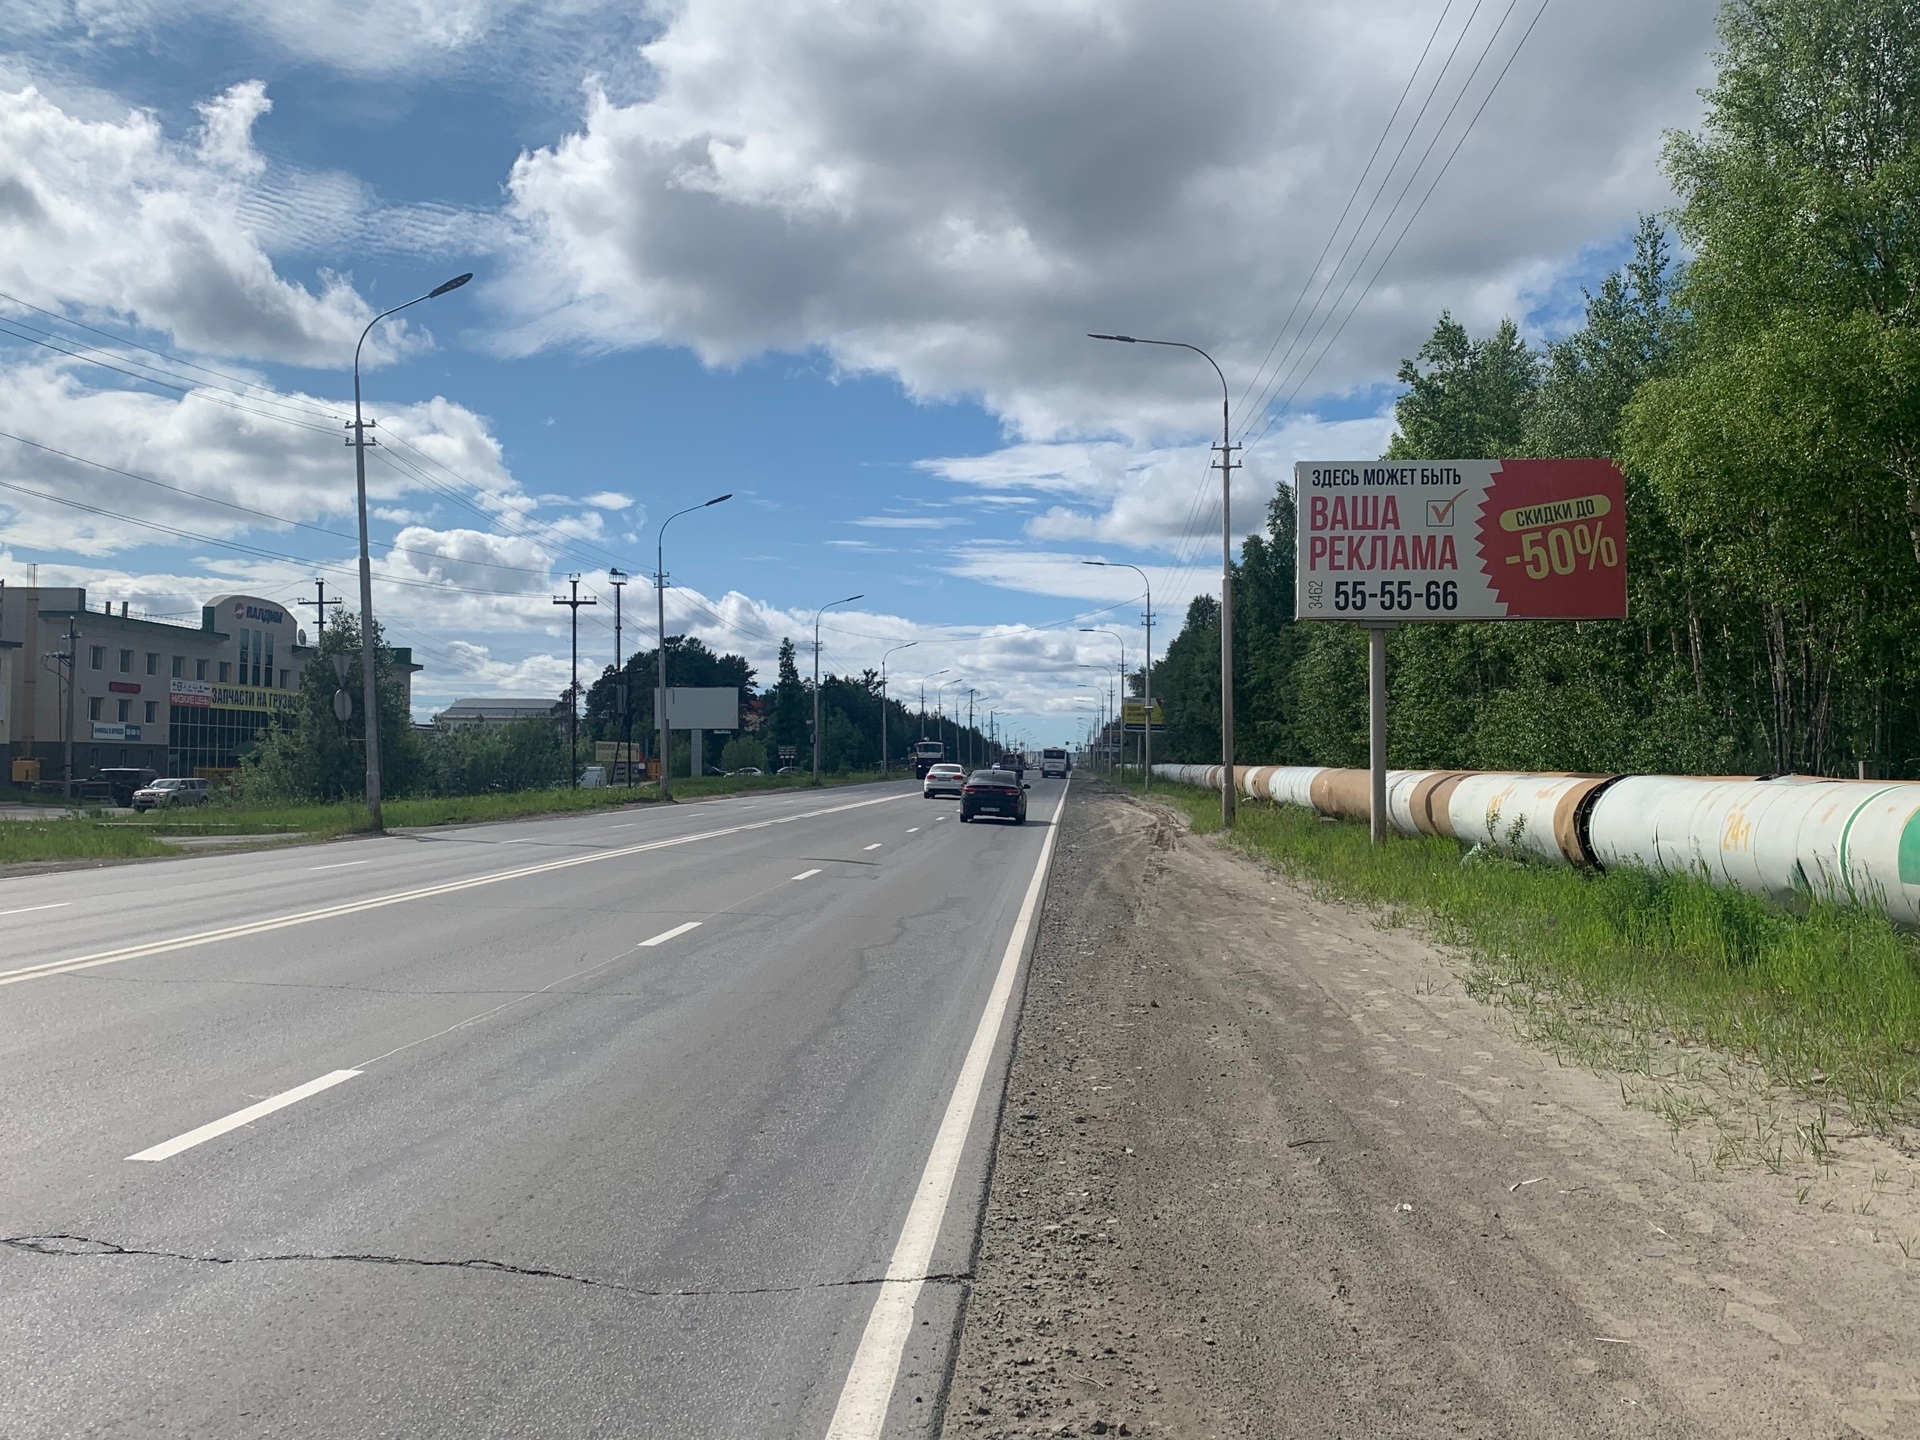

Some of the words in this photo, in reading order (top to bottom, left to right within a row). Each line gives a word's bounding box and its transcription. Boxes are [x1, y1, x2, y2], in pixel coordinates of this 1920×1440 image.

[1312, 469, 1359, 488] ЗДЕСЬ
[1363, 468, 1417, 486] МОЖЕТ
[1420, 468, 1462, 485] БЫТЬ
[1310, 495, 1400, 531] ВАША
[1515, 502, 1573, 527] СКИДКИ
[1576, 499, 1595, 518] ДО
[1309, 535, 1459, 571] РЕКЛАМА
[1505, 521, 1618, 580] -50%
[1308, 580, 1323, 609] 3462
[1334, 580, 1458, 611] 55-55-66
[211, 687, 255, 707] ЗАПЧАСТИ
[256, 690, 267, 708] НА
